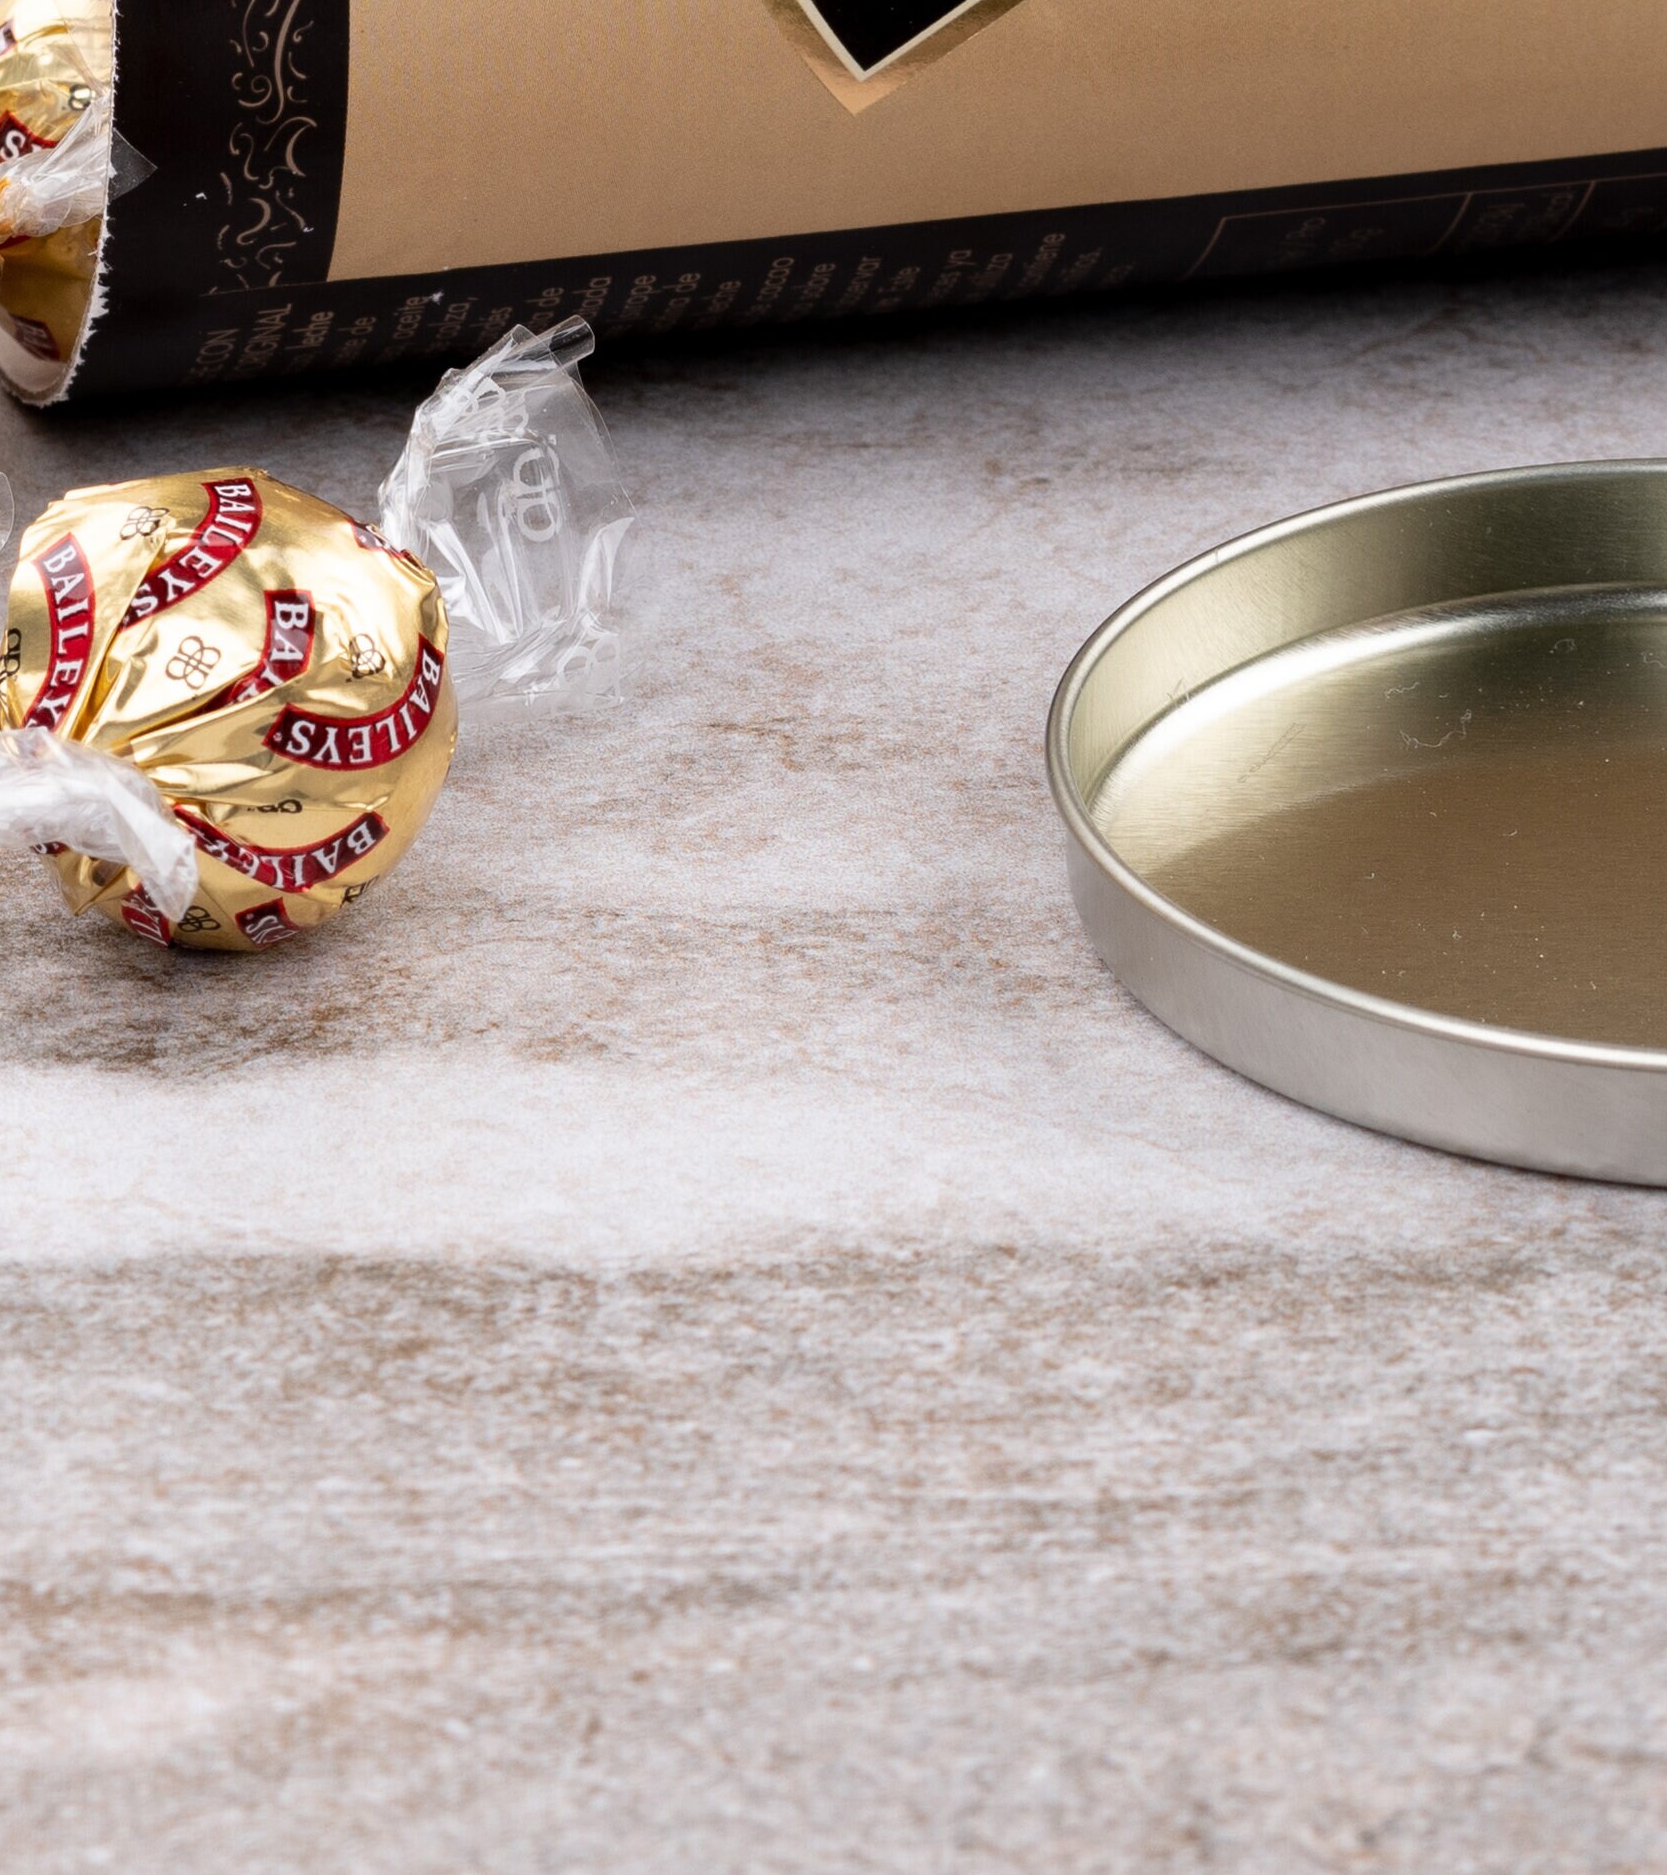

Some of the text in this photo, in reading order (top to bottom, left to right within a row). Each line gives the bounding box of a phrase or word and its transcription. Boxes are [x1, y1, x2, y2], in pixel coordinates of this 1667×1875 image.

[392, 295, 430, 340] aceite
[526, 286, 565, 308] de
[287, 310, 335, 351] leche
[132, 483, 256, 618] BAILEYS
[287, 647, 441, 764] BAILEYS
